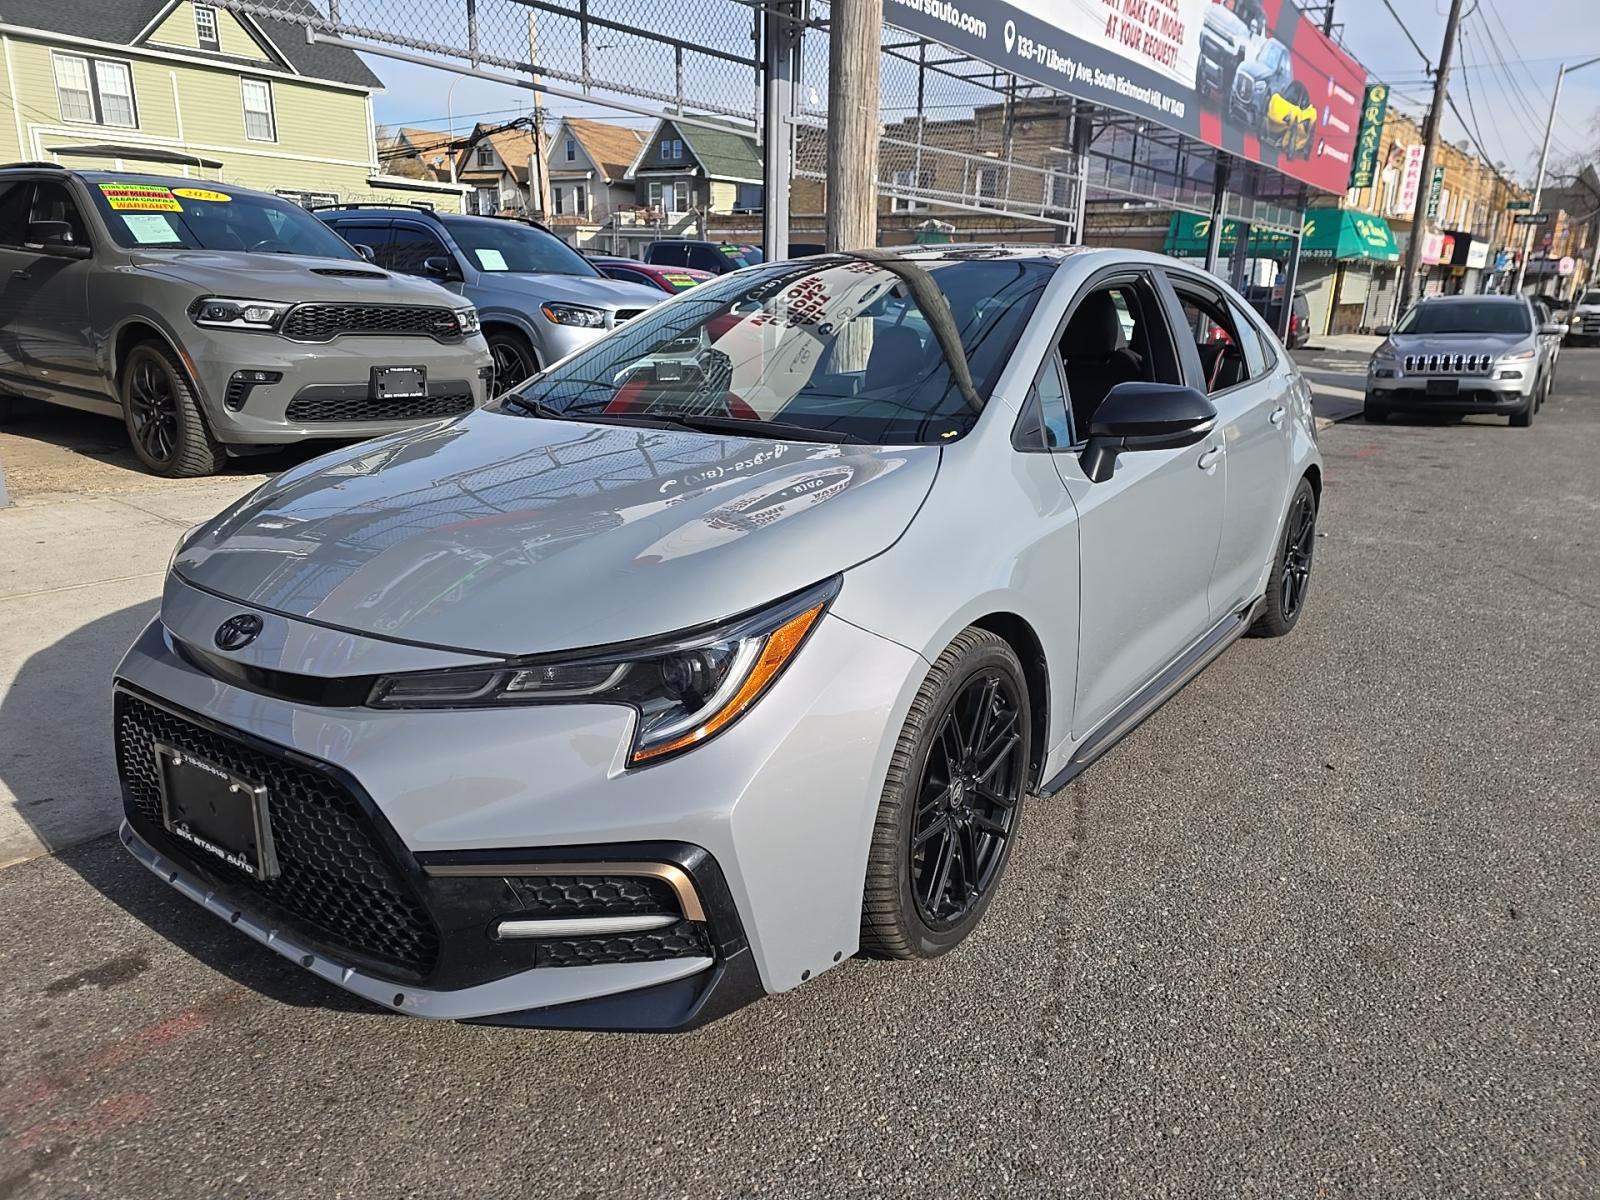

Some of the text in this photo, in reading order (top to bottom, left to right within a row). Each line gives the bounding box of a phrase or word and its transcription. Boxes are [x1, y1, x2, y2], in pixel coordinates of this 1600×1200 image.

[1104, 13, 1118, 39] AT
[1119, 19, 1142, 50] YOUR
[1017, 35, 1047, 64] 133-17
[1046, 49, 1077, 82] Liberty
[1075, 62, 1093, 86] Ave,
[1093, 68, 1116, 91] South
[1116, 76, 1151, 104] Richmond
[1405, 146, 1422, 211] BAKERY
[176, 827, 254, 874] SIX STARS AUTO
